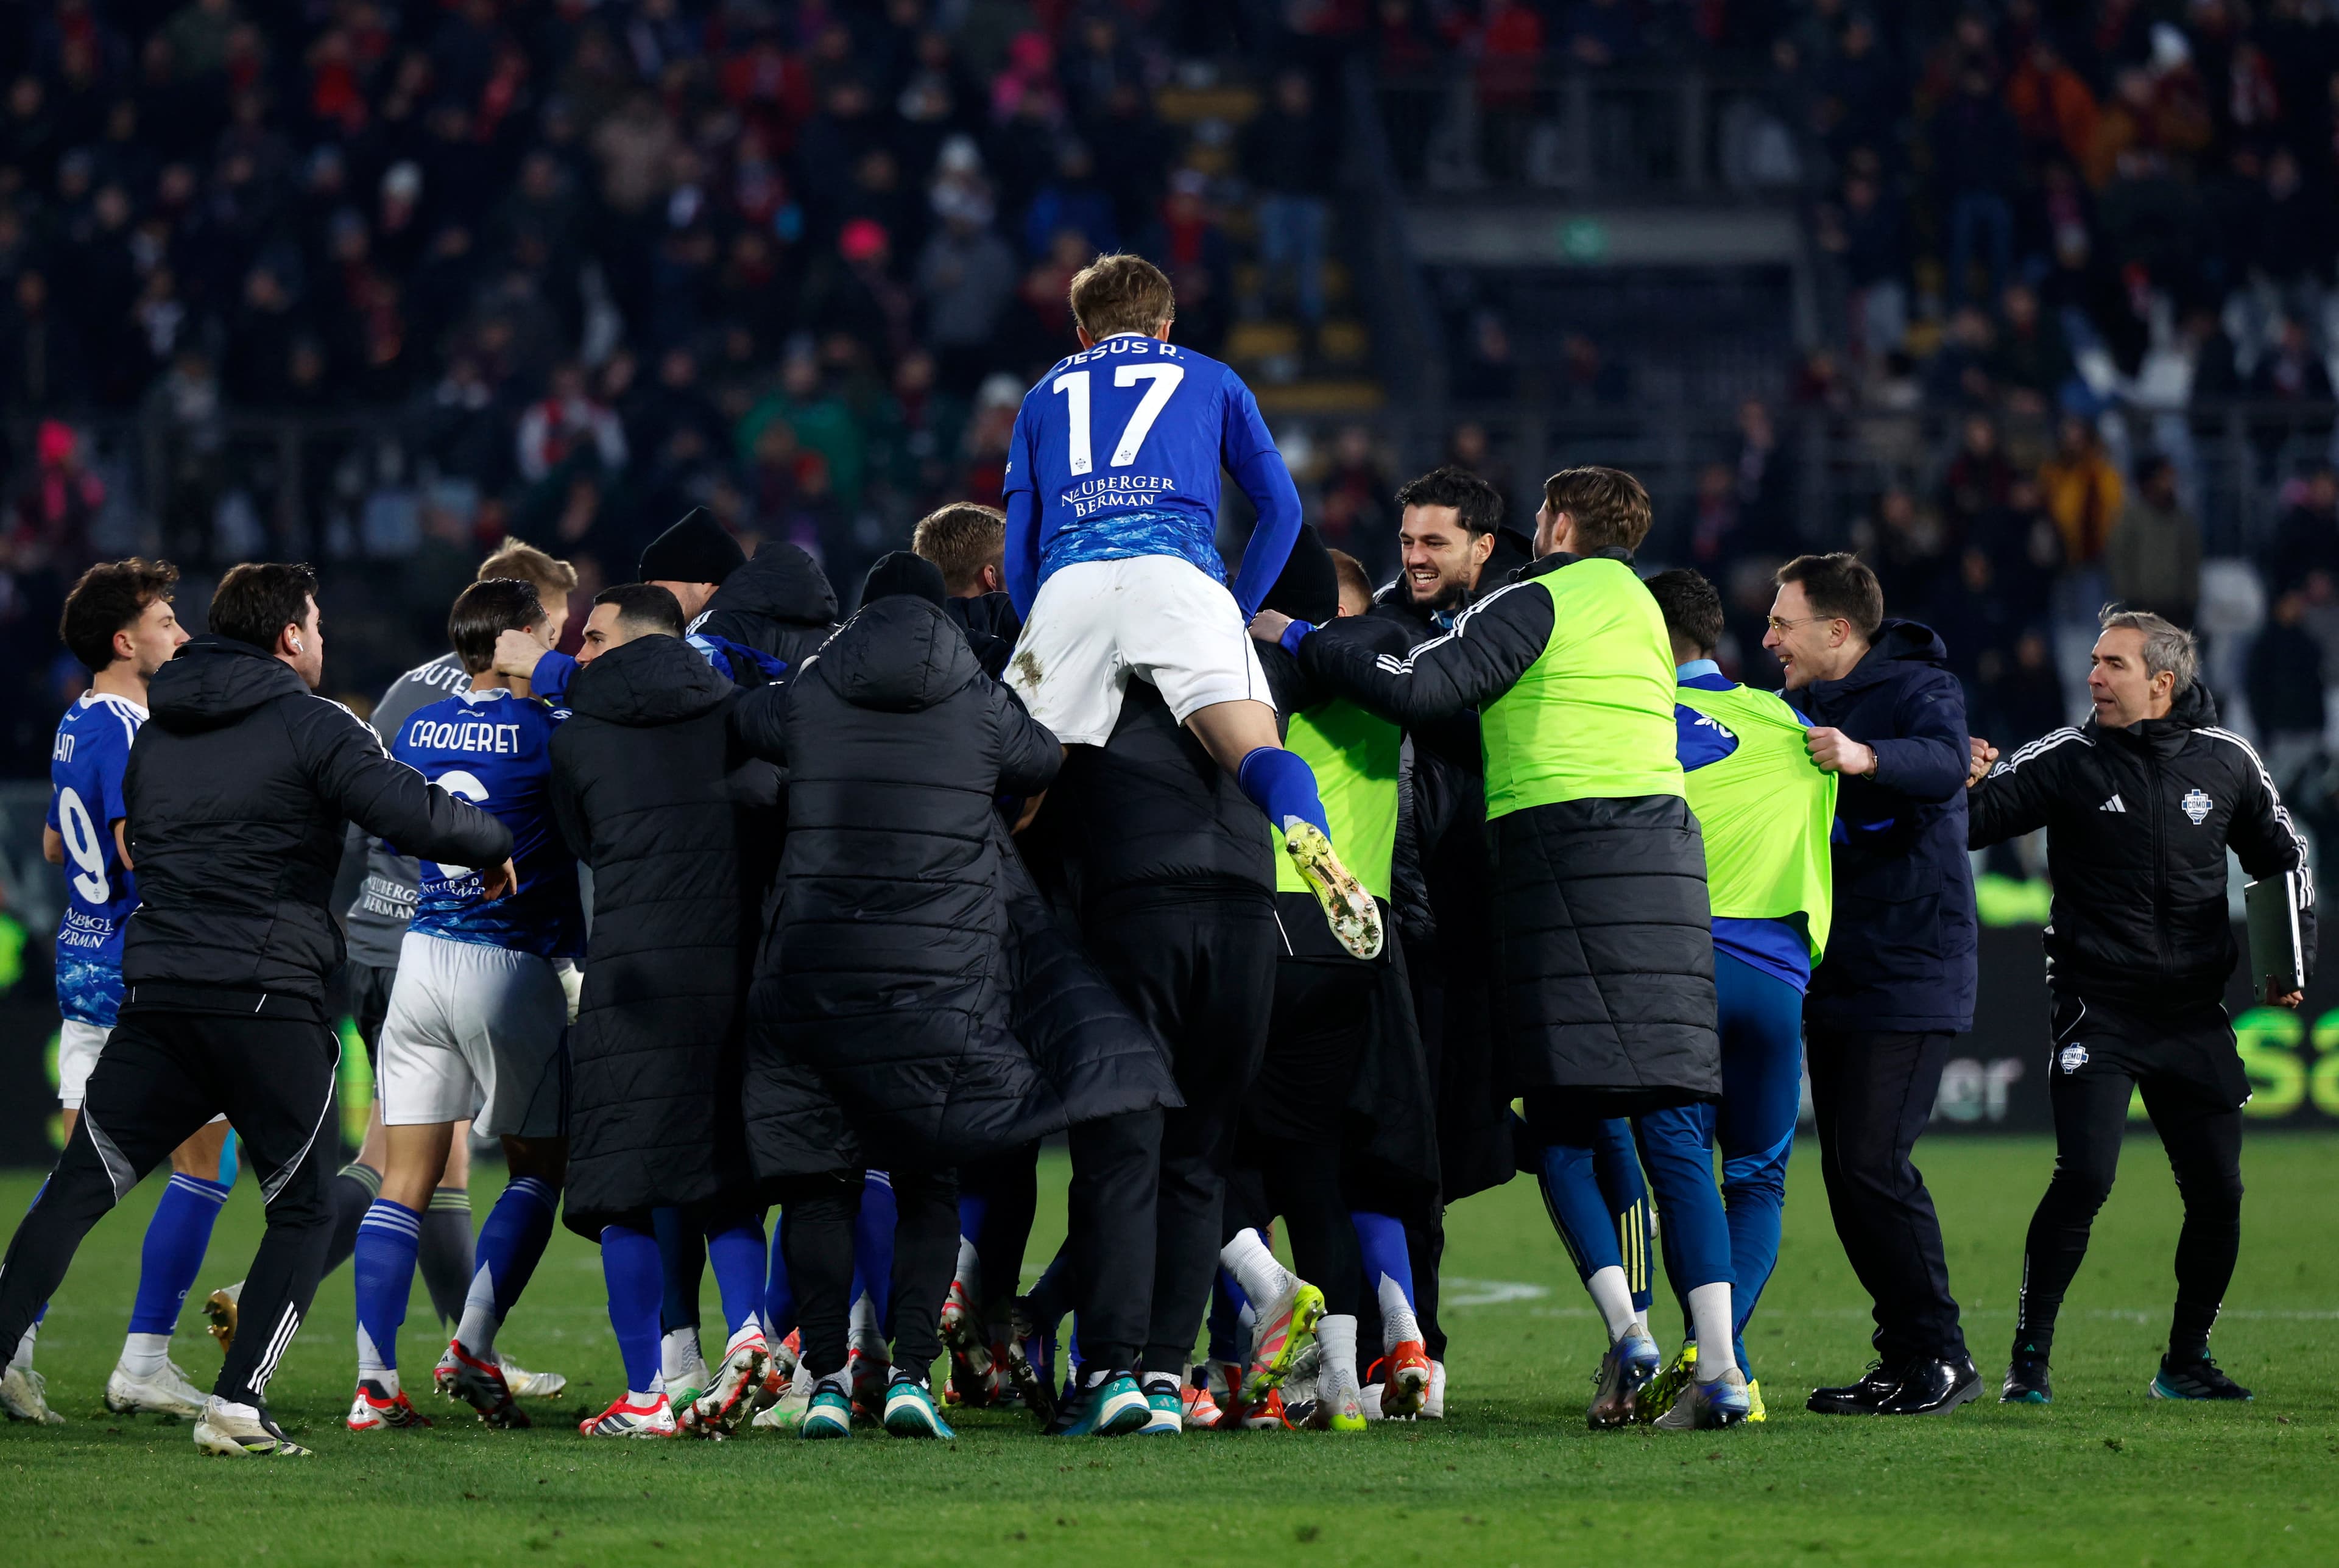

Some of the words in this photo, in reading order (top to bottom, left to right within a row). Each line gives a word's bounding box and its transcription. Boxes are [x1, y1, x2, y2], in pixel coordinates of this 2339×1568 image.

[1159, 343, 1184, 360] R.
[1053, 362, 1184, 476] 17
[1062, 476, 1176, 507] NEUBERGER
[1074, 493, 1155, 518] BERMAN
[409, 720, 520, 753] CAQUERET
